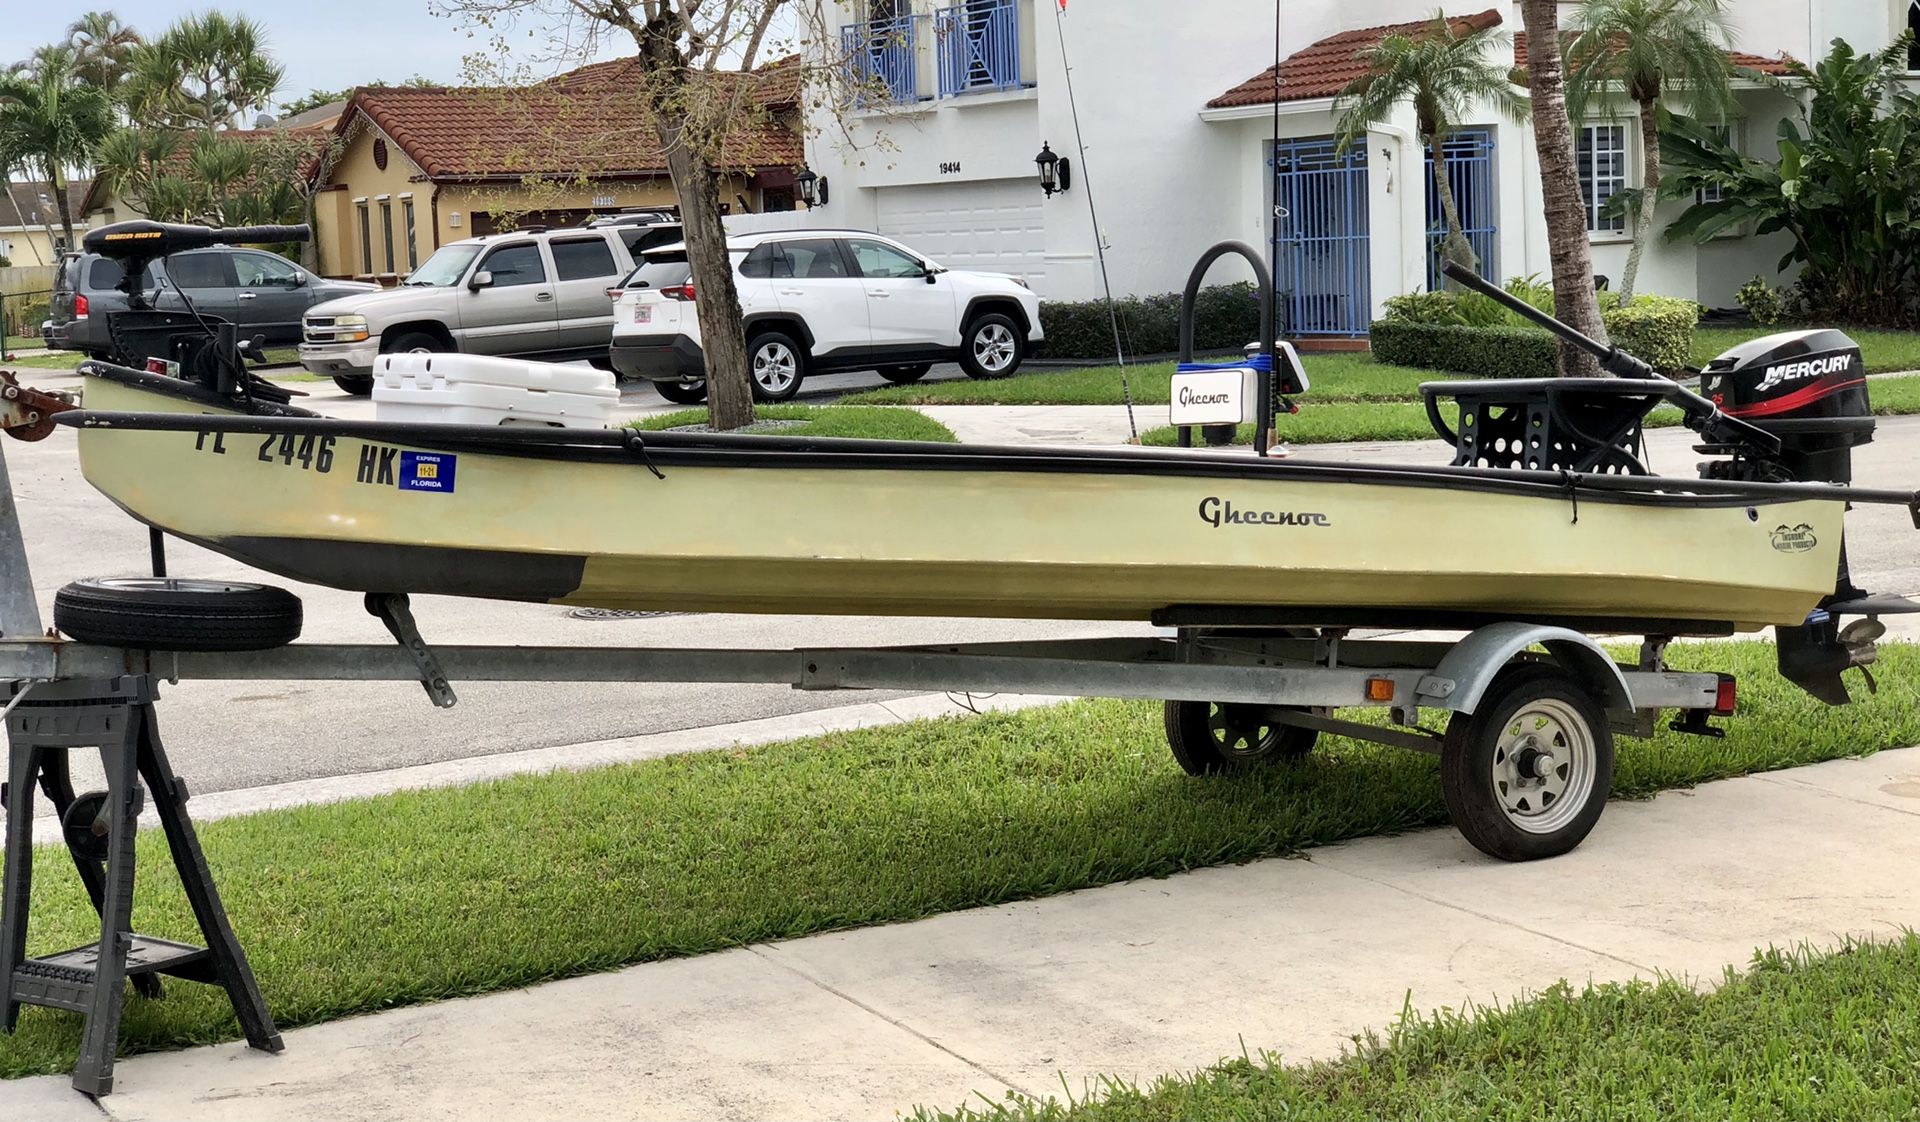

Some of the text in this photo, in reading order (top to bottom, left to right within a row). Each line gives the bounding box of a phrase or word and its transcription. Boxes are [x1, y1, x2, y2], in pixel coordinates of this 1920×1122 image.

[939, 161, 961, 175] 19414
[1755, 354, 1851, 391] MERCURY
[1179, 386, 1230, 408] Gheenoe
[258, 434, 336, 473] 2446
[357, 444, 398, 486] HK
[419, 466, 435, 477] 11-21
[410, 479, 442, 488] FLORIDA
[1199, 496, 1331, 528] Gheenoe
